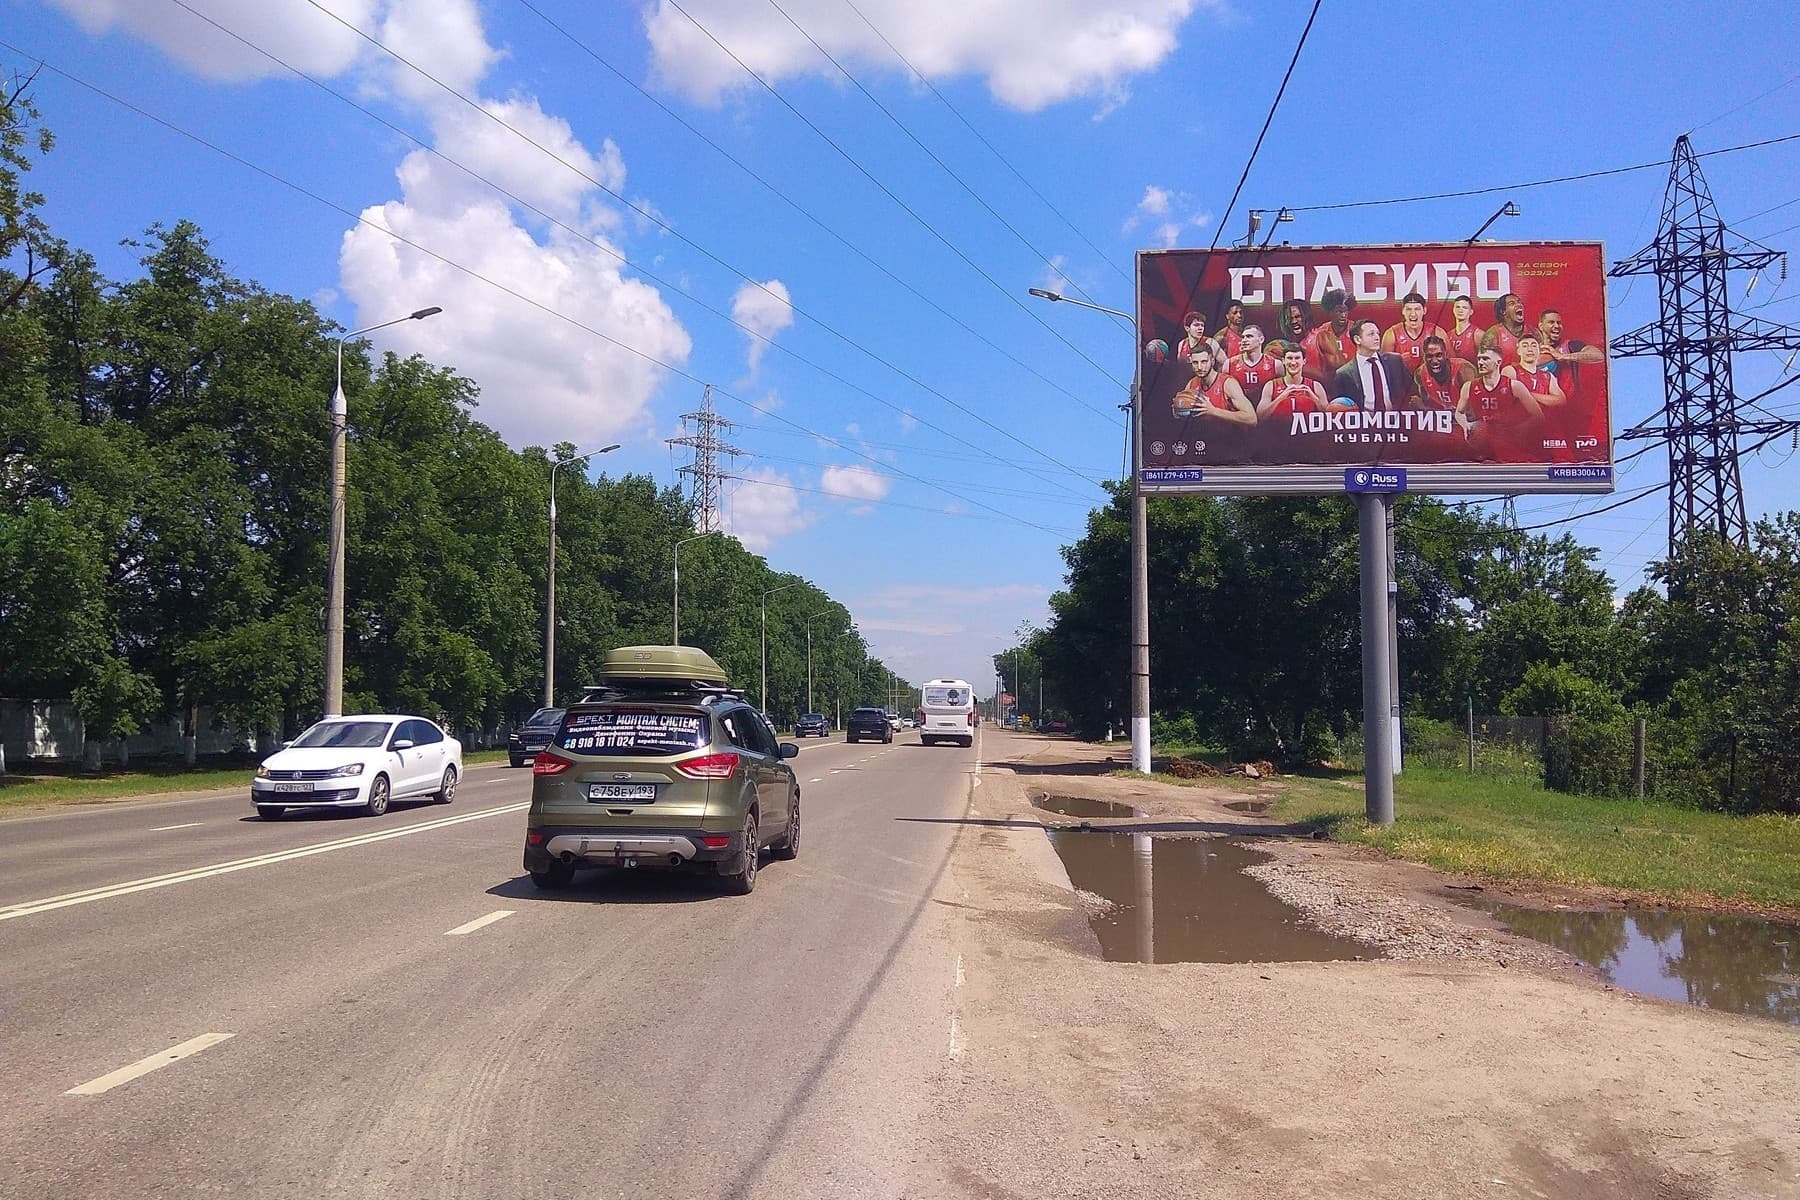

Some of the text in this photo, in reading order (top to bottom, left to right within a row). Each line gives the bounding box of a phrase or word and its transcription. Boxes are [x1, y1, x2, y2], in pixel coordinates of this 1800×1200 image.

[1228, 262, 1511, 304] СПАСИБО
[1411, 346, 1420, 358] 9
[1244, 371, 1258, 384] 16
[1436, 390, 1452, 403] 15
[1481, 397, 1498, 410] 35
[1290, 410, 1453, 436] ЛОКОМОТИВ
[1334, 433, 1409, 443] КУБАНЬ
[1371, 473, 1398, 483] Russ
[1553, 468, 1607, 477] KRBB30041A
[616, 714, 658, 726] МОНТАЖ
[570, 736, 635, 749] 8 918 18 11 024
